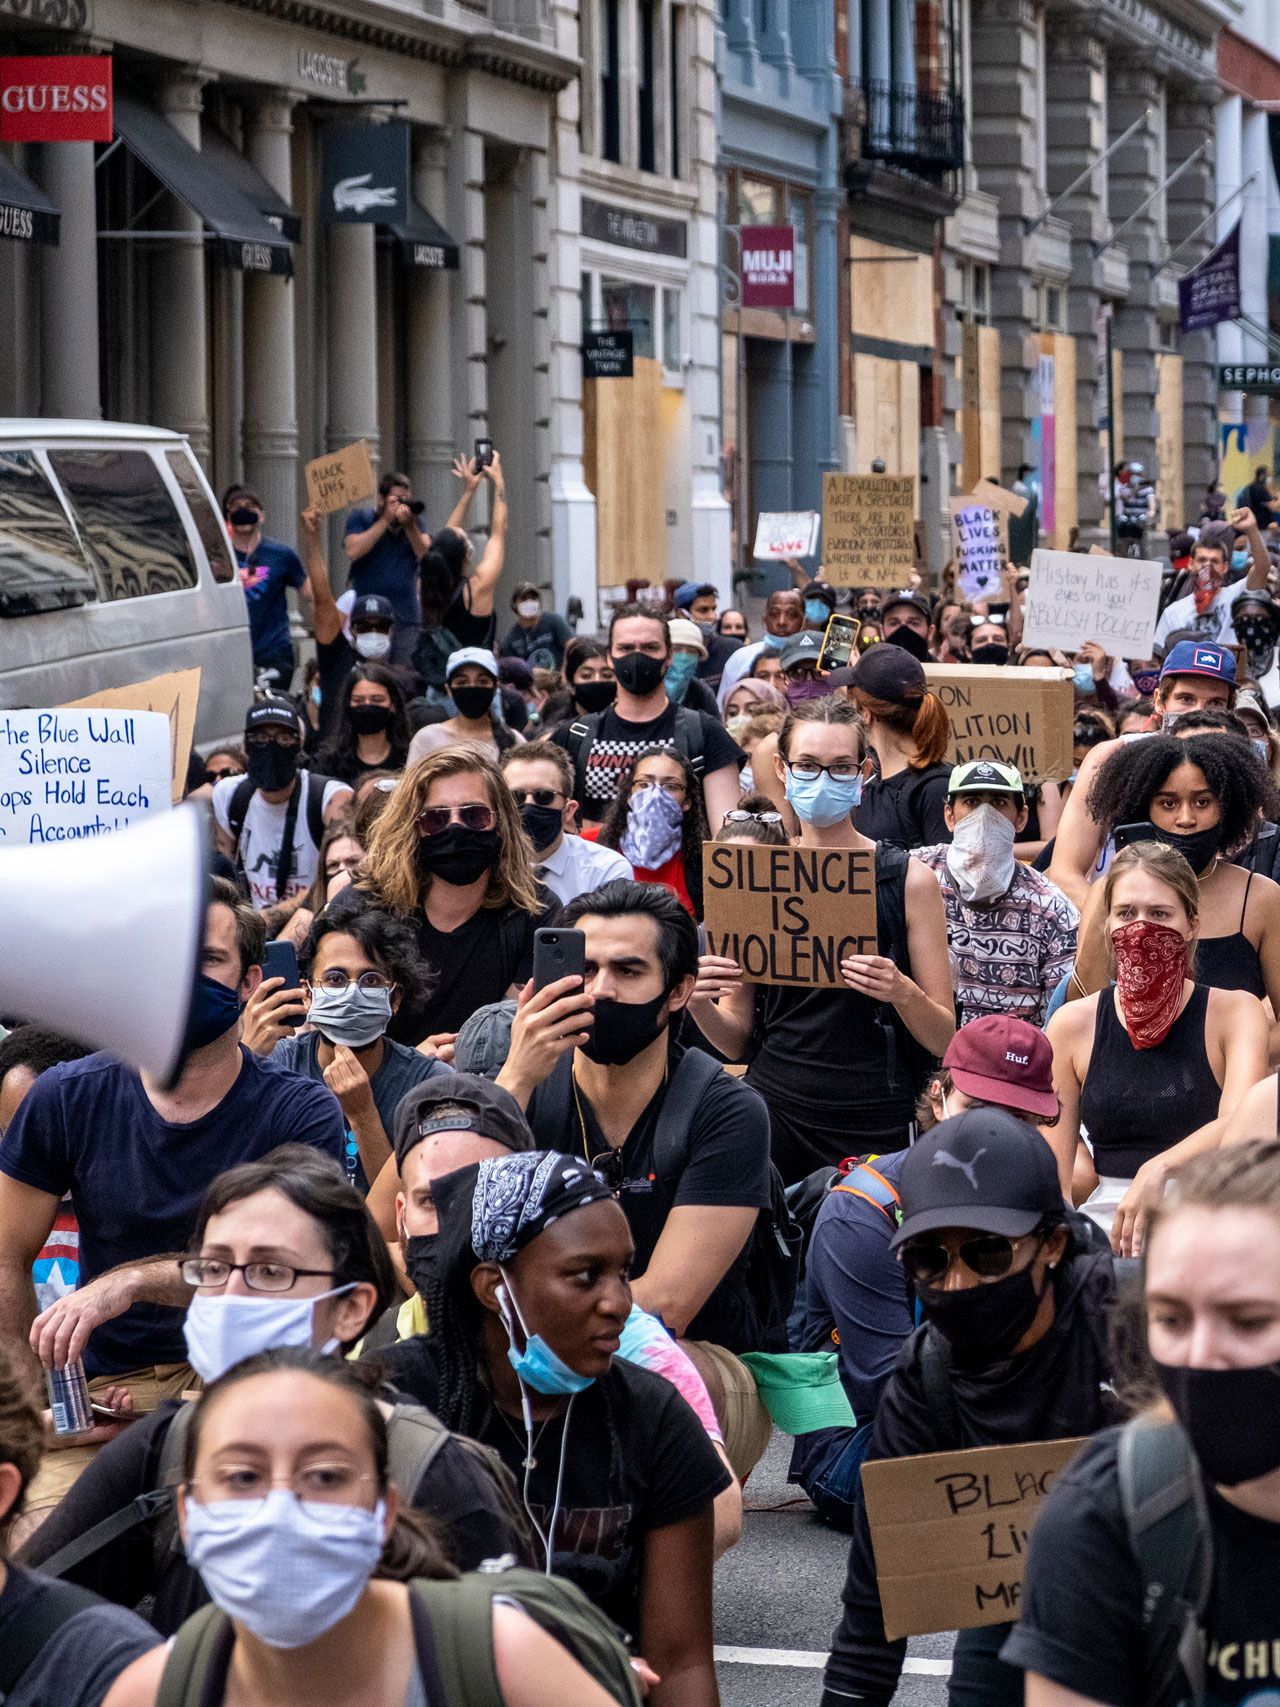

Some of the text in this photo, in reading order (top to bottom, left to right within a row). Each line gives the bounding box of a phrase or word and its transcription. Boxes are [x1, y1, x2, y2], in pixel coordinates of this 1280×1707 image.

[2, 85, 107, 113] GUESS
[242, 243, 272, 271] GUESS
[743, 250, 792, 272] MUJI
[597, 336, 616, 348] THE
[586, 349, 625, 361] VINTAGE
[827, 475, 838, 493] A
[830, 494, 852, 506] NOT
[954, 508, 1001, 527] BLACK
[958, 525, 1000, 541] LIVES
[769, 540, 803, 553] LOVE
[956, 543, 1006, 558] FUCKING
[959, 560, 1009, 574] MATTER
[1035, 559, 1087, 589] History
[1095, 568, 1118, 589] has
[1055, 588, 1080, 604] eyes
[1085, 592, 1100, 603] on
[1028, 600, 1089, 630] ABOLISH
[1095, 611, 1150, 641] POLICE!
[38, 713, 79, 743] Blue
[88, 717, 135, 745] Wall
[949, 712, 1031, 740] LITION
[18, 748, 91, 775] Silence
[45, 780, 86, 805] Hold
[97, 778, 149, 808] Each
[708, 848, 871, 894] SILENCE
[772, 895, 810, 935] IS
[1005, 1052, 1029, 1065] Huf.
[981, 1523, 1028, 1560] Li
